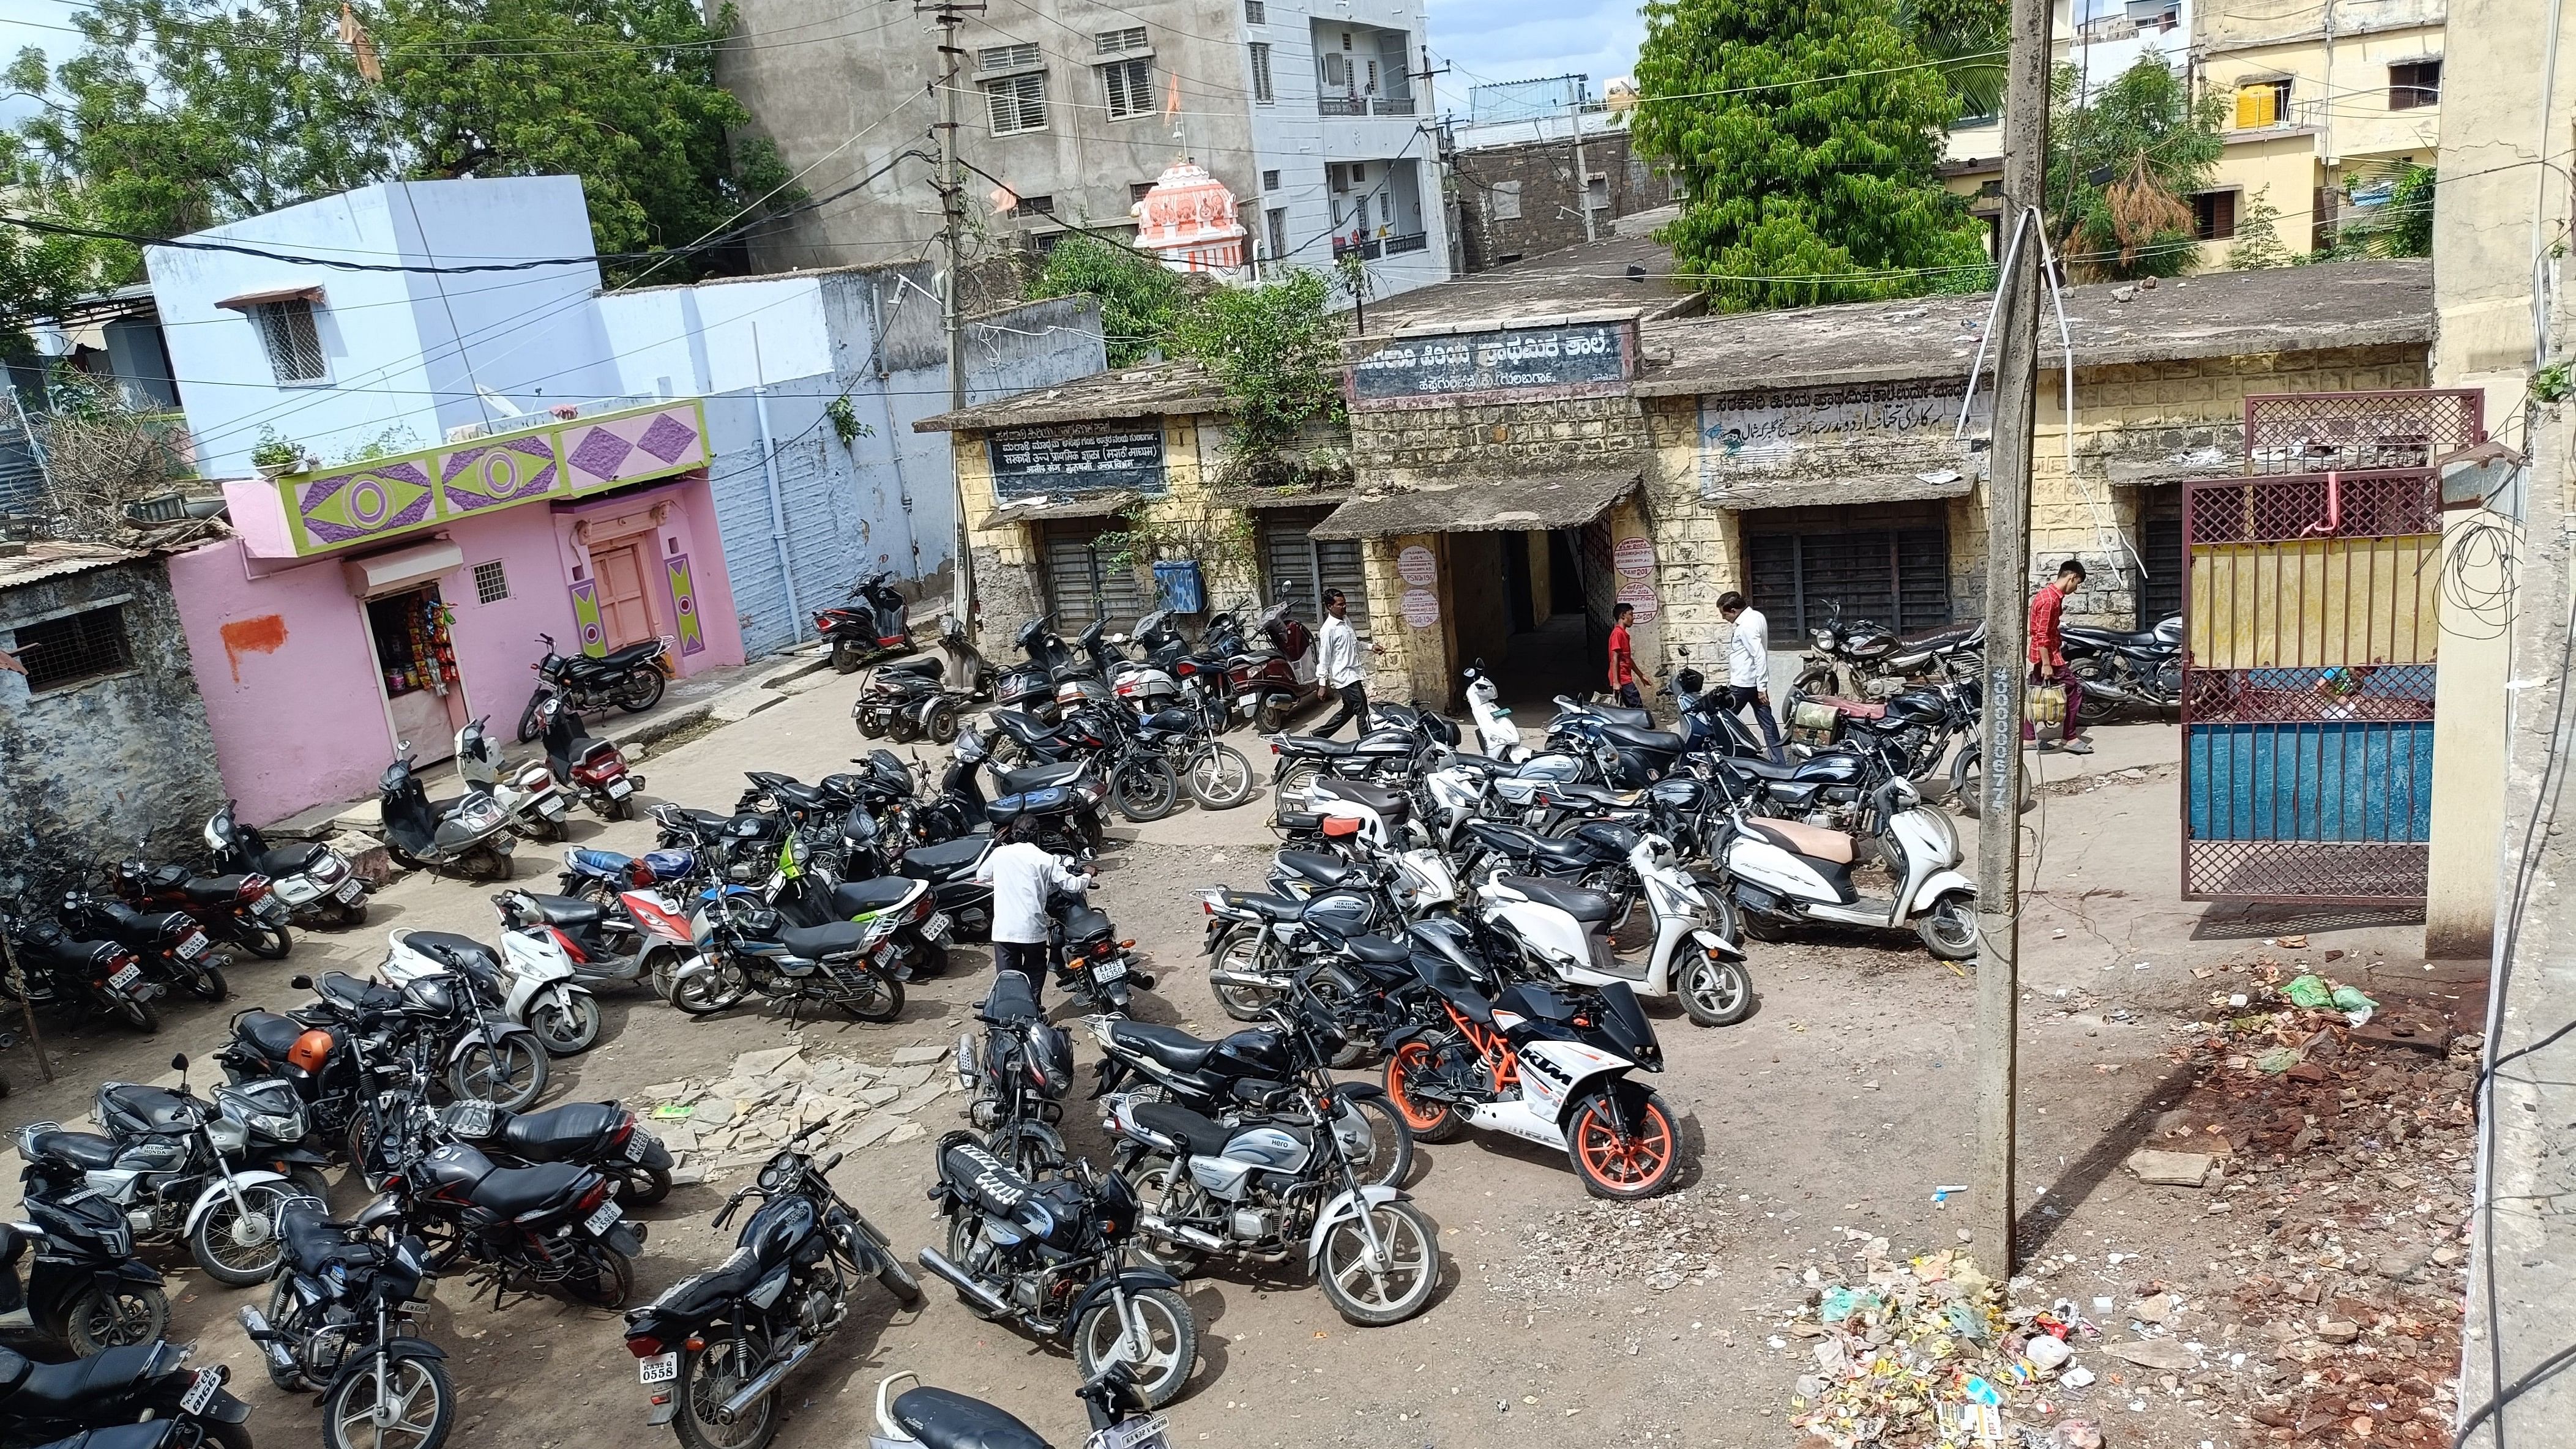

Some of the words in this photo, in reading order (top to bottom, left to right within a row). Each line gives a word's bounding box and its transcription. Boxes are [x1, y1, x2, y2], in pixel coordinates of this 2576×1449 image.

[1716, 395, 1765, 412] ಸರಕಾರಿ
[1770, 392, 1810, 409] ಹಿರಿಯ
[1003, 452, 1031, 464] सरकारी
[928, 920, 947, 939] 2492
[184, 939, 206, 957] 6938
[1518, 1050, 1573, 1087] KTM
[1272, 1139, 1288, 1148] Hero
[592, 1215, 602, 1224] KA
[600, 1204, 611, 1215] 38
[643, 1366, 673, 1380] 0558
[185, 1393, 196, 1405] KA
[193, 1381, 203, 1391] 32
[192, 1376, 217, 1412] 8166
